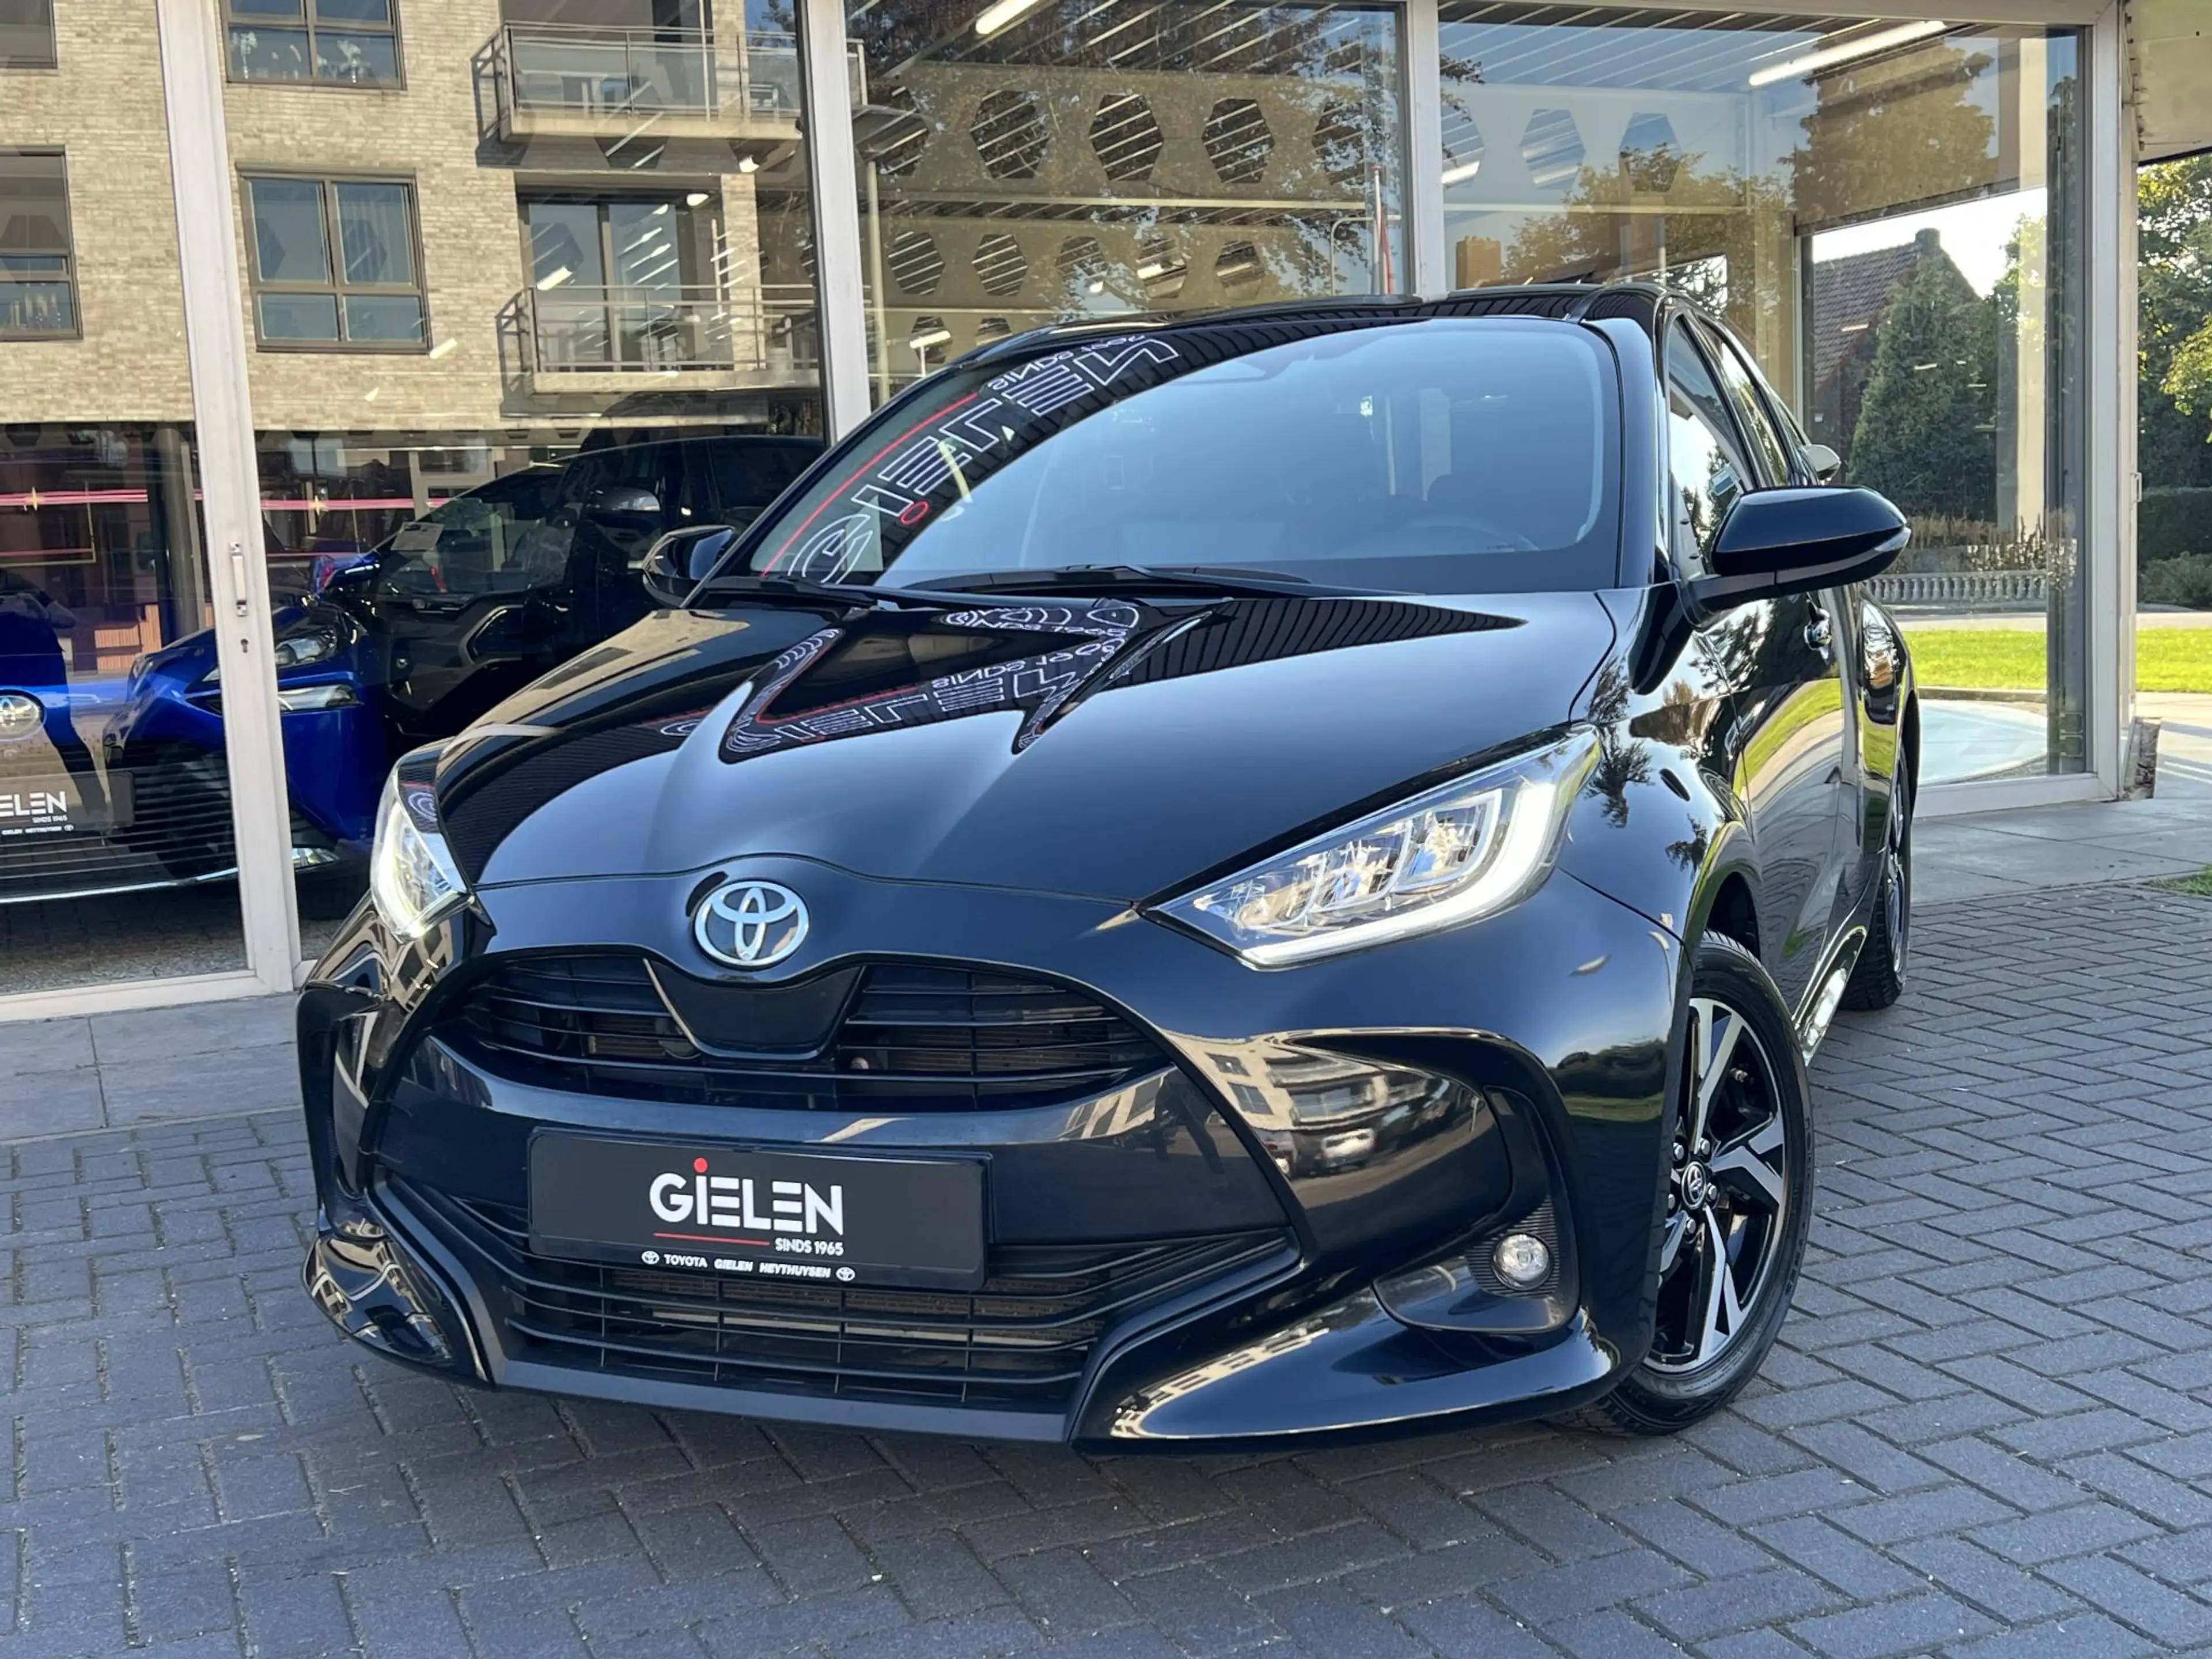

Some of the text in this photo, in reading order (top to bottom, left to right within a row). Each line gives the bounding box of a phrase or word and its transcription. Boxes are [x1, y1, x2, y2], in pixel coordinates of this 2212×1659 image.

[775, 1238, 844, 1256] SINDS 1965
[664, 1253, 831, 1278] TOYOTA GIELEN HEYTHUYSEN
